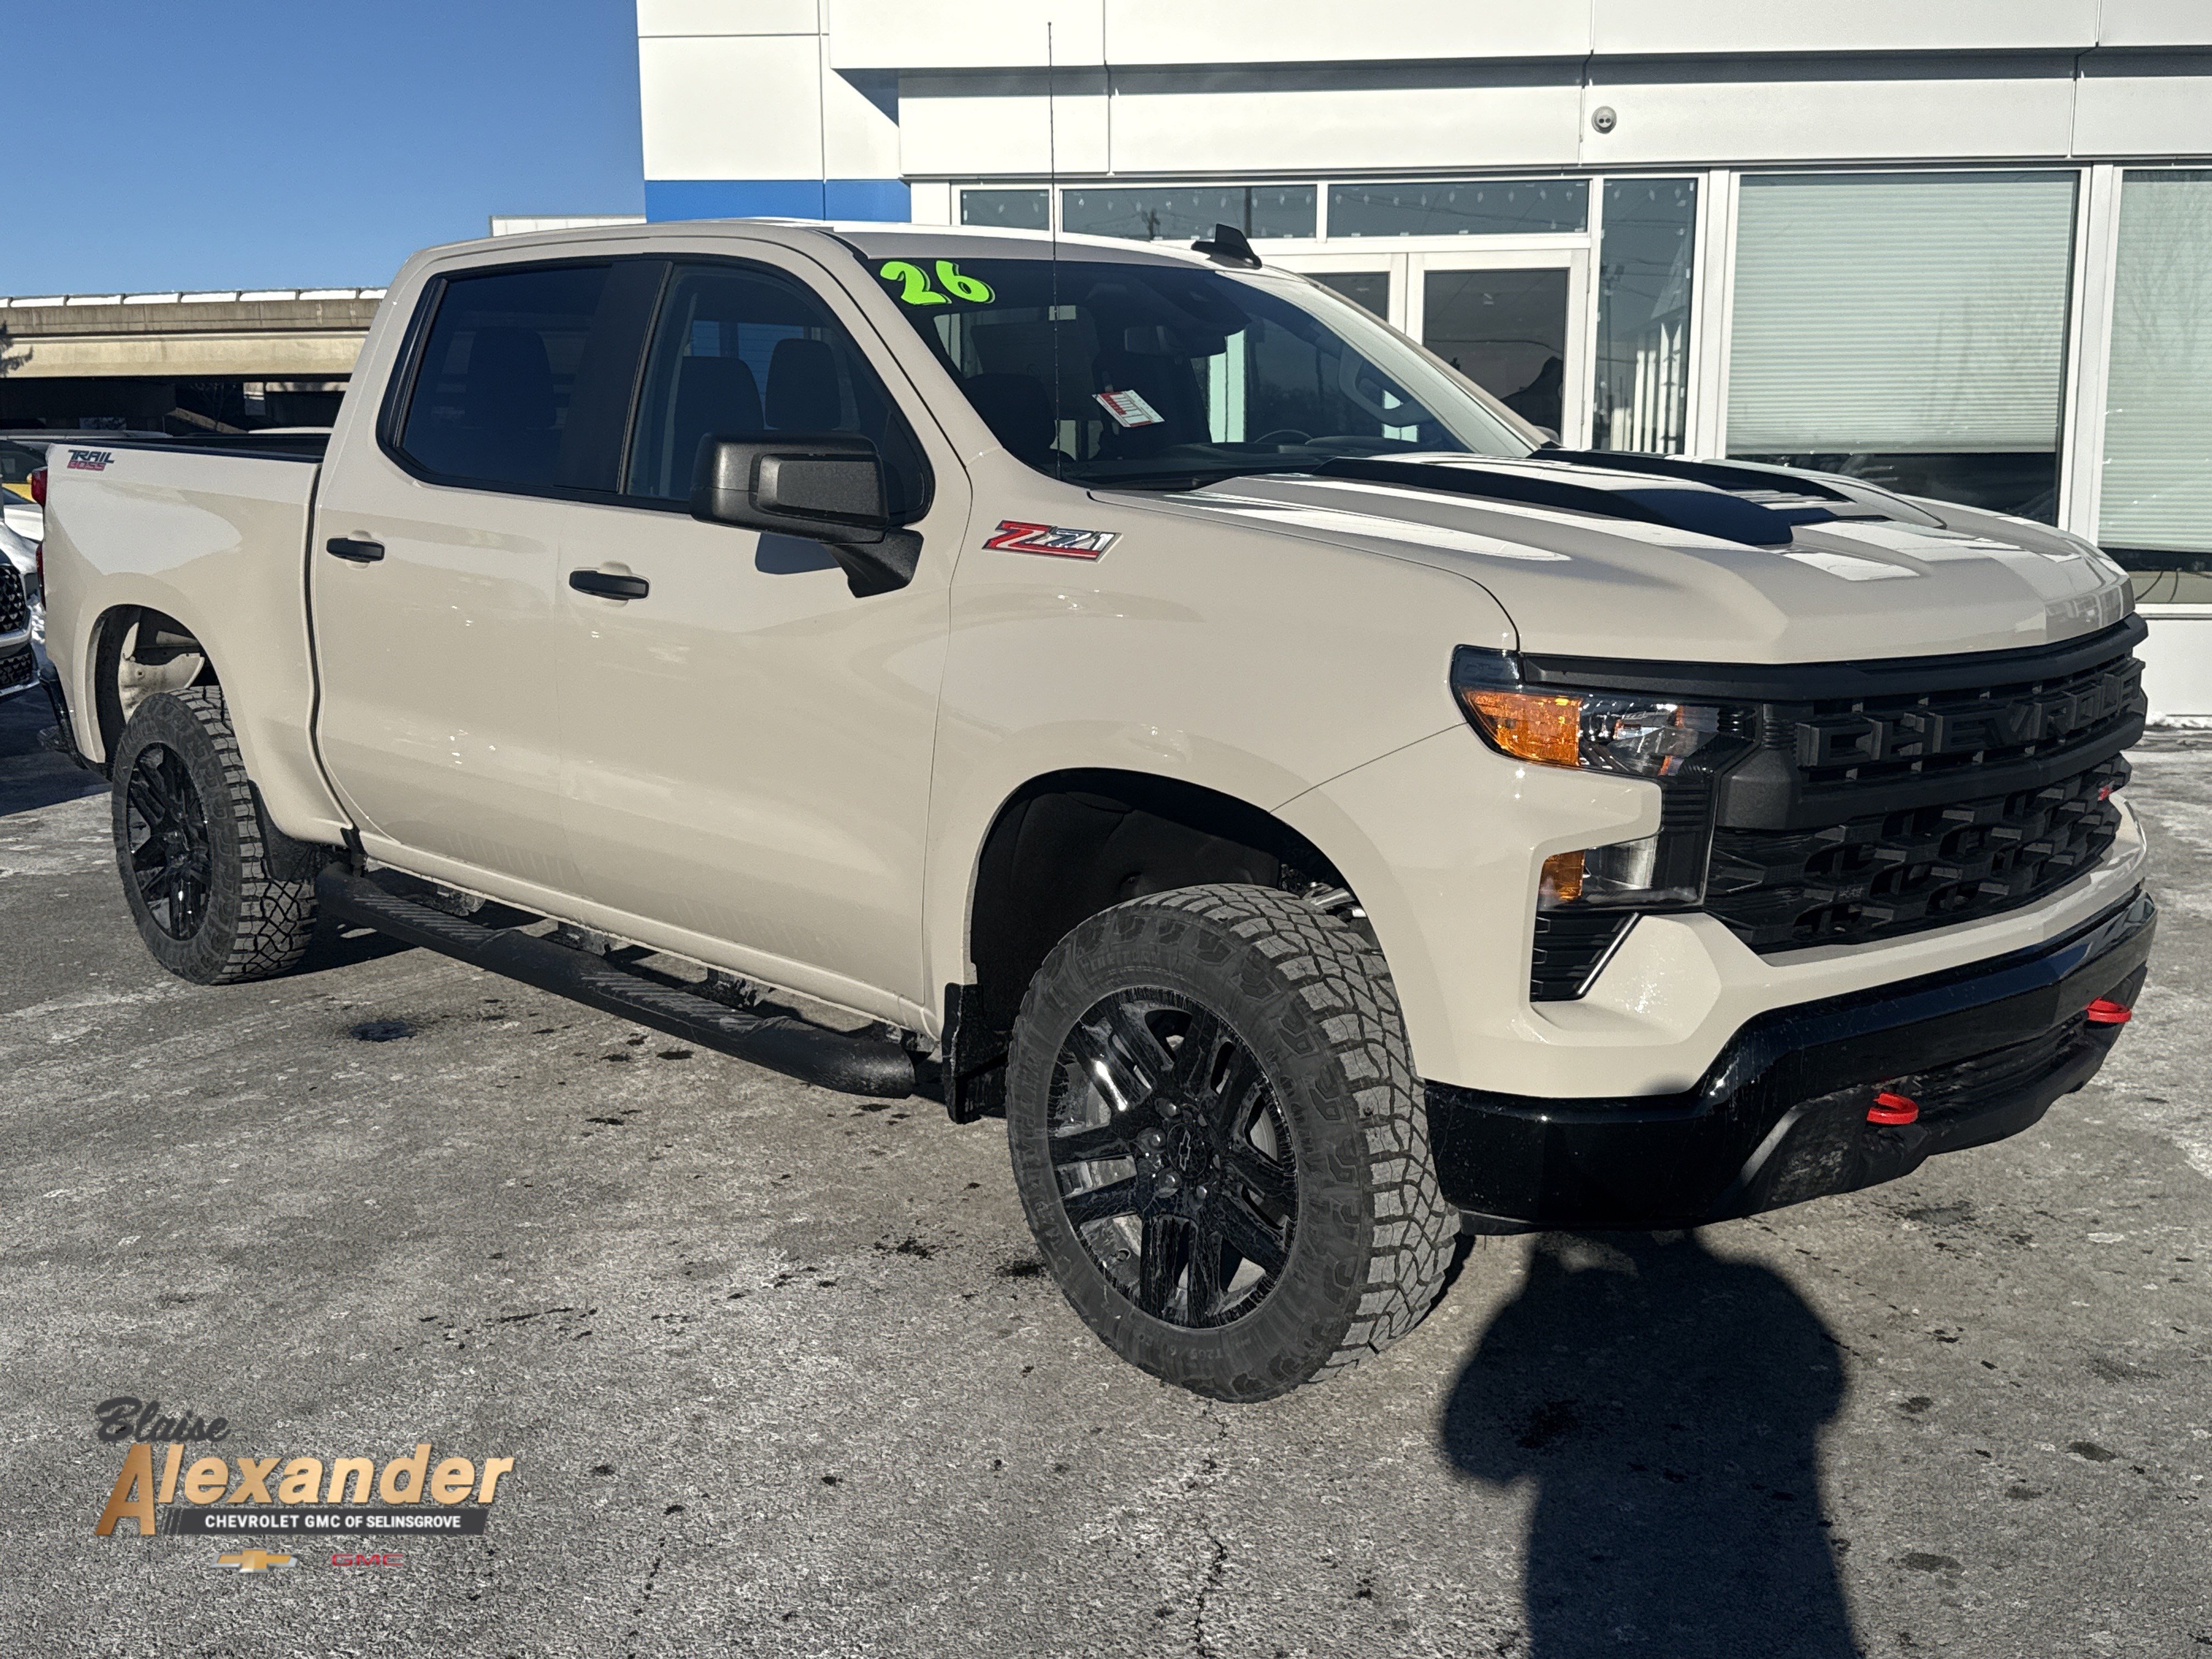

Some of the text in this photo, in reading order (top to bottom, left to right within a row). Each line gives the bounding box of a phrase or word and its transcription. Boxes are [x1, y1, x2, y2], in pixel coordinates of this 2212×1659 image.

[879, 259, 995, 306] 26
[67, 461, 106, 471] BOSS
[68, 449, 115, 464] TRAIL
[981, 520, 1124, 563] Z71
